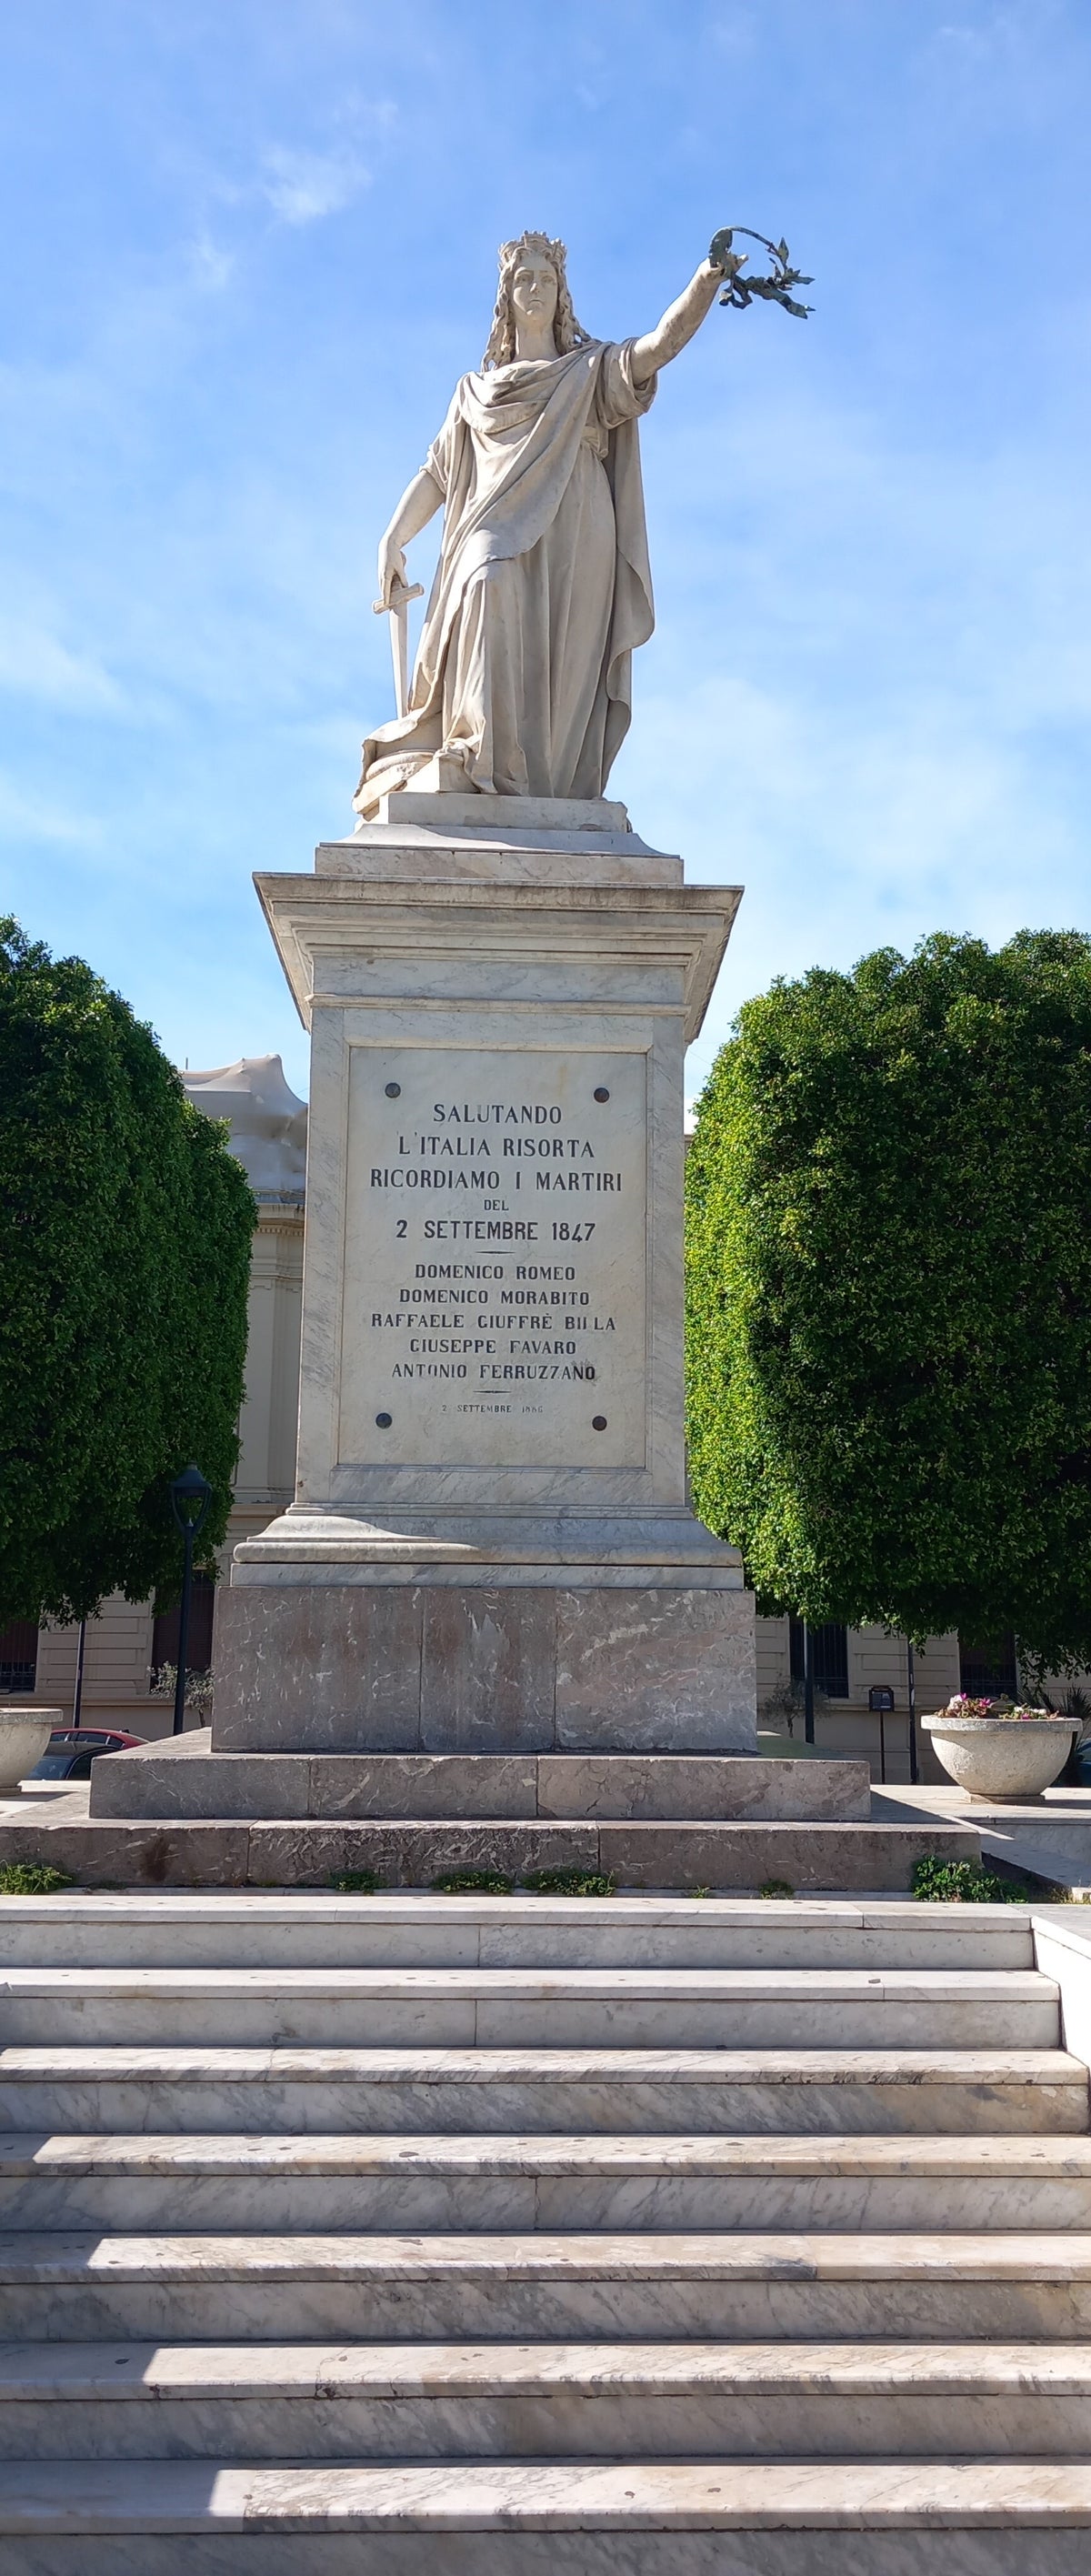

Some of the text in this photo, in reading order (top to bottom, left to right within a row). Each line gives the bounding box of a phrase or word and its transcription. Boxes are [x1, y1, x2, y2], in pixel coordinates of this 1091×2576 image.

[433, 1104, 563, 1125] SALUTANDO
[398, 1131, 596, 1158] L'ITALIA RISORTA
[370, 1168, 622, 1192] RICORDIAMO I MARTIRI
[483, 1199, 509, 1212] DEL
[395, 1219, 596, 1243] 2 SETTEMBRE 1847
[415, 1264, 576, 1281] DOMENICO ROMEO
[399, 1288, 590, 1306] DOMENICO MORABITO
[371, 1313, 465, 1328] RAFFAELE
[409, 1338, 576, 1355] GIUSEPPE FAVARO
[391, 1364, 596, 1381] ANTONIO FERRUZZANO
[441, 1404, 447, 1413] 2
[456, 1405, 513, 1414] SETTEMBRE
